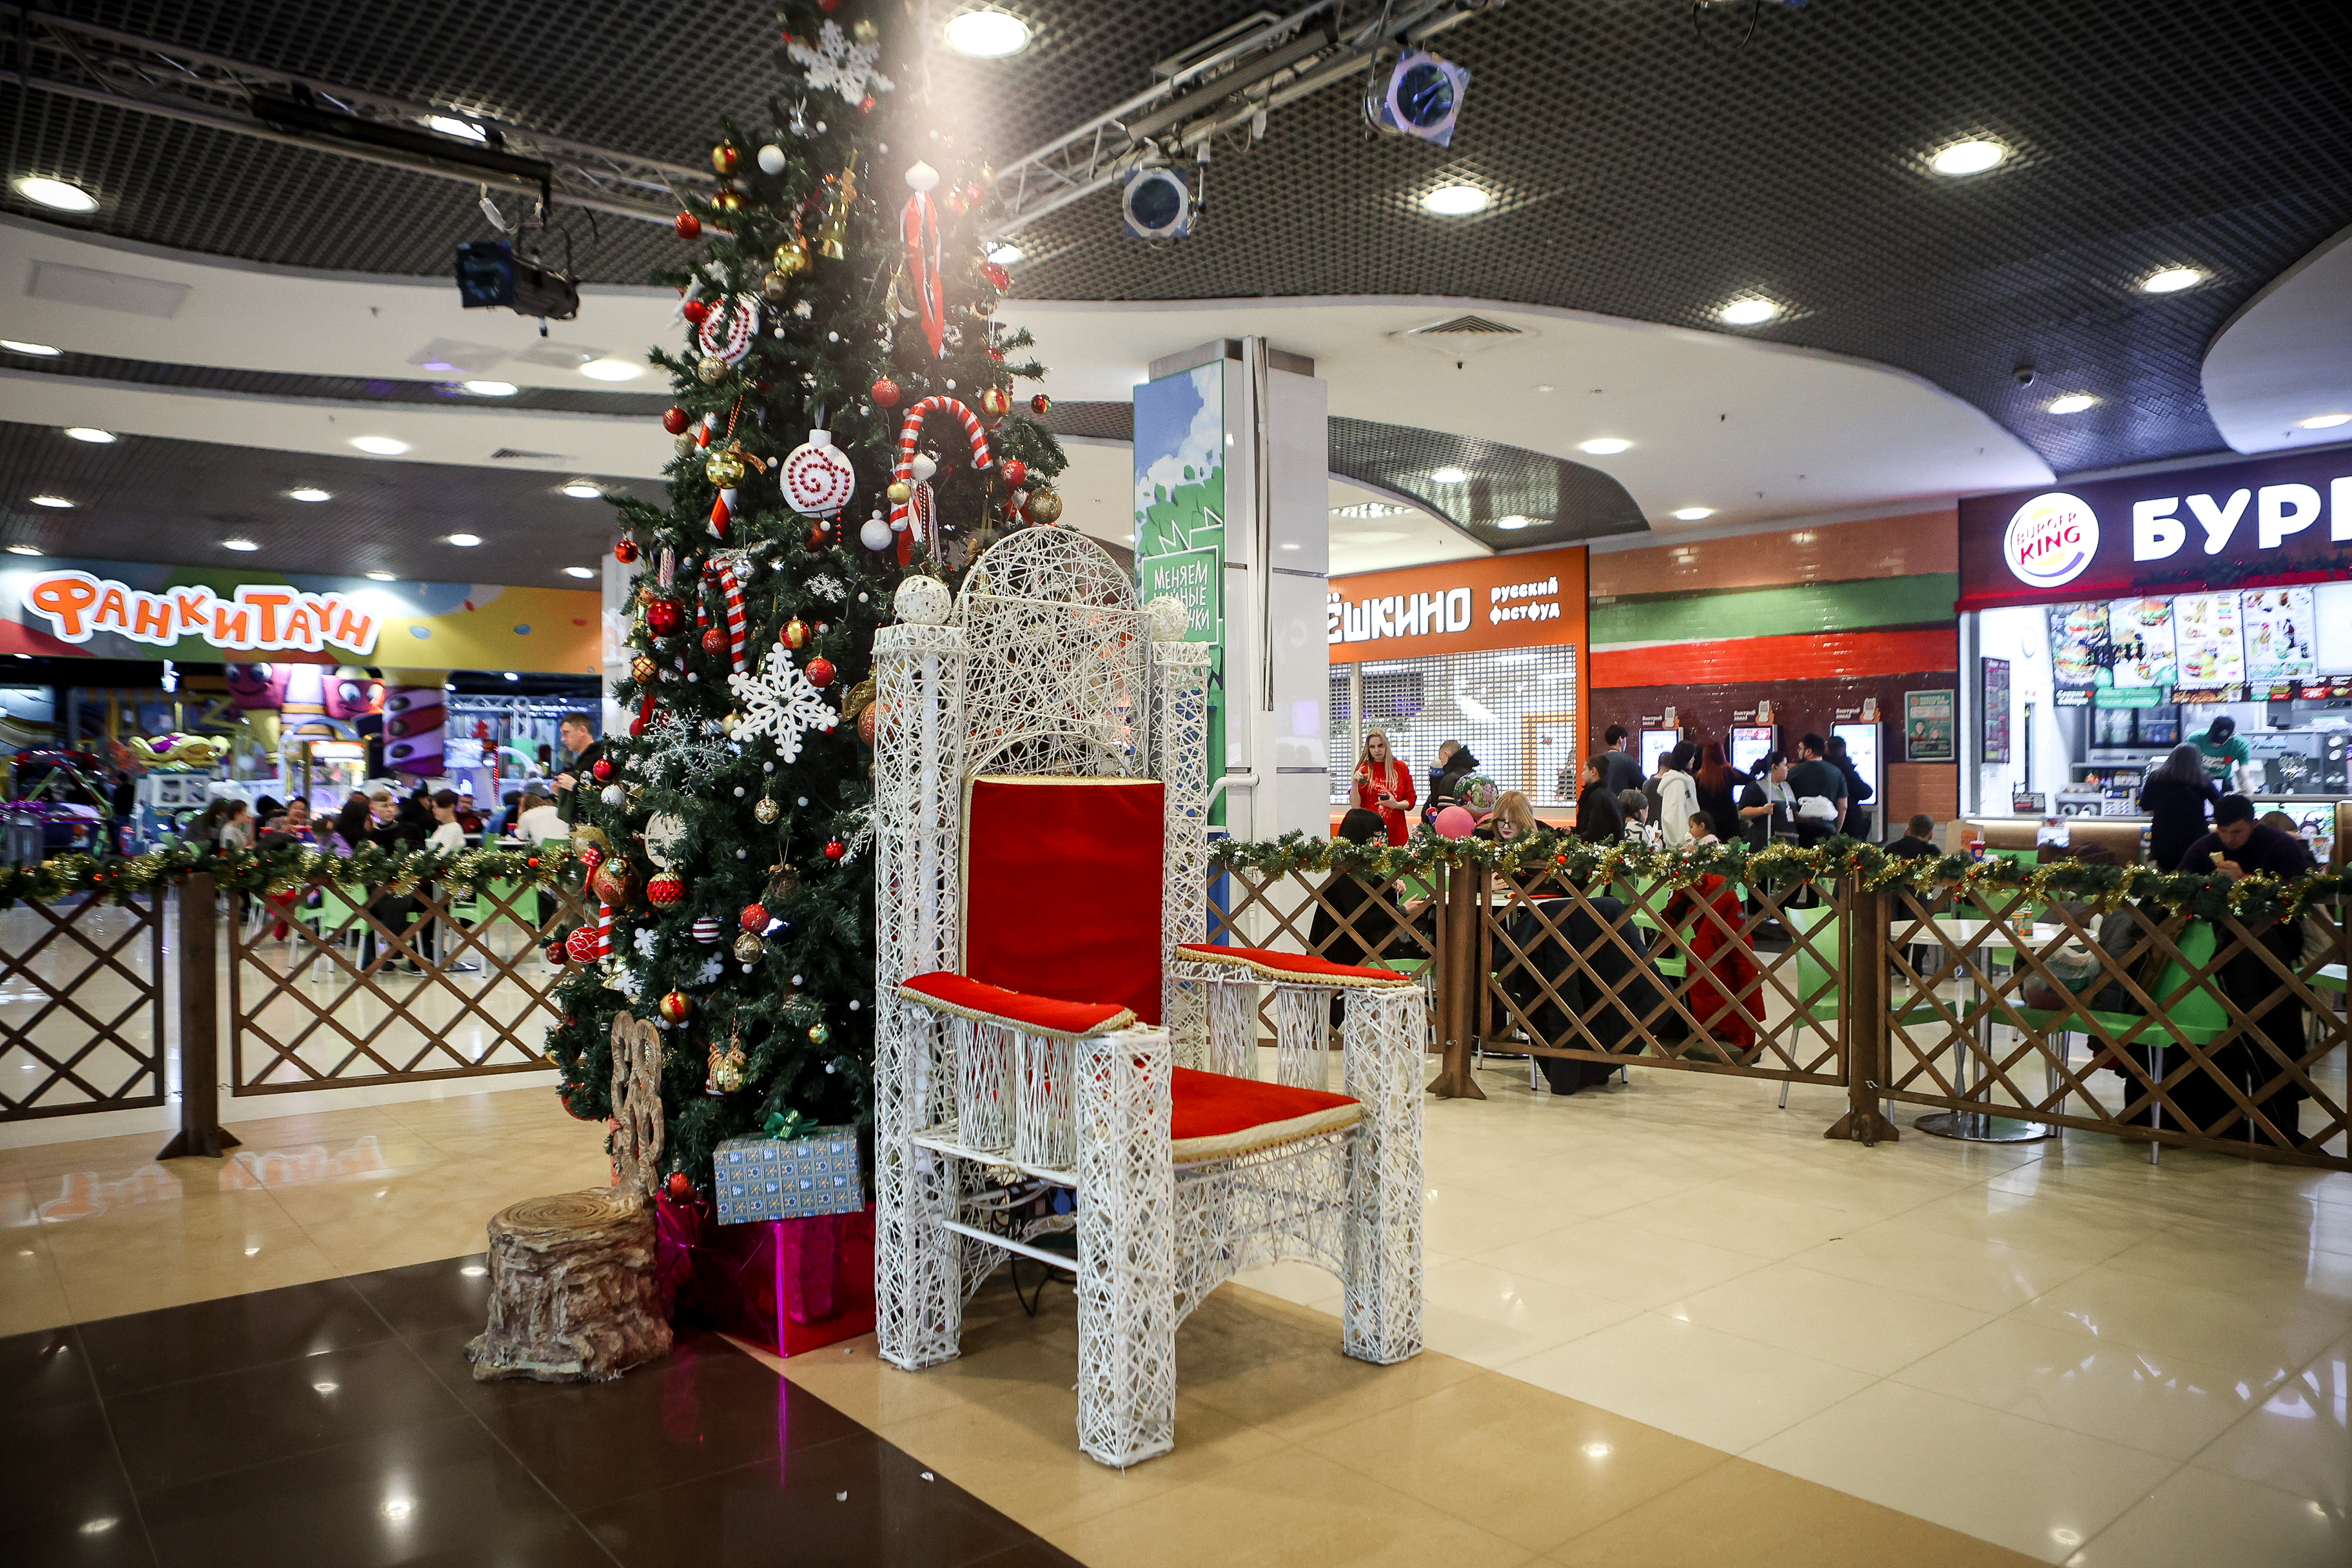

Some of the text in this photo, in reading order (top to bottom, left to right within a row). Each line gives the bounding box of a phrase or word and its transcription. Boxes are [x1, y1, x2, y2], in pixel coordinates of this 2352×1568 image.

[2020, 525, 2081, 565] KING
[1154, 560, 1209, 591] МЕНЯЕМ
[1490, 576, 1559, 604] русский
[1489, 601, 1560, 625] фастфуд
